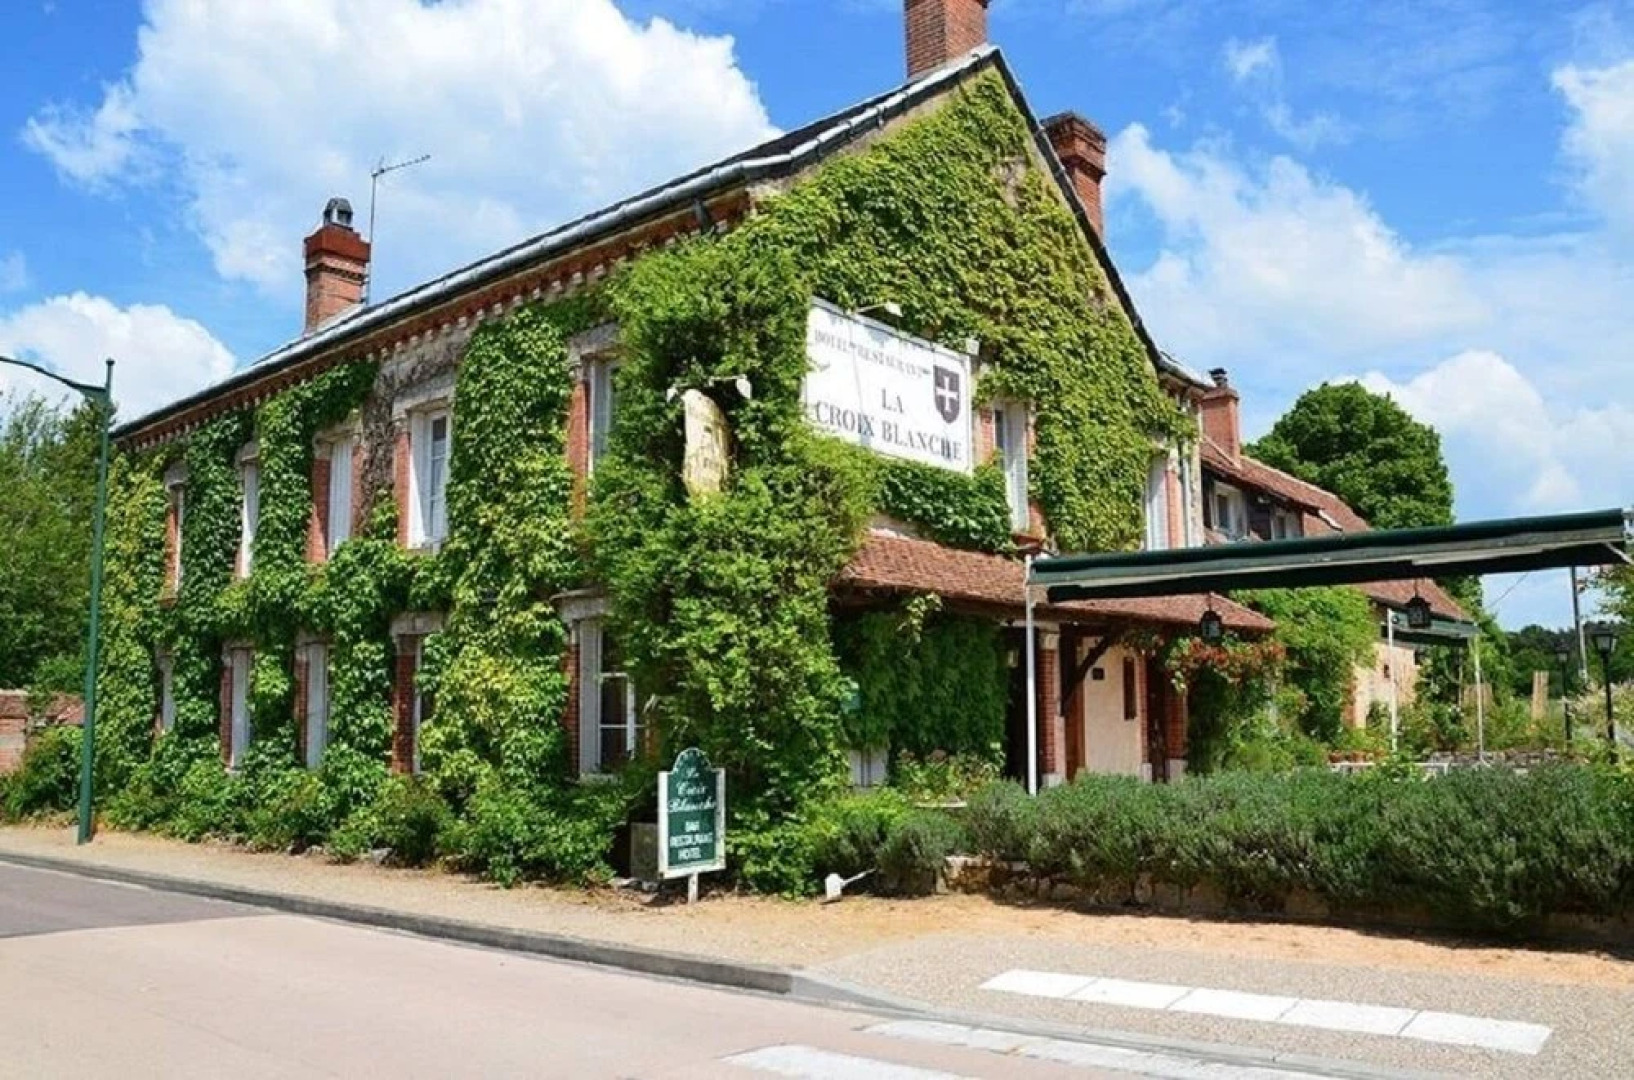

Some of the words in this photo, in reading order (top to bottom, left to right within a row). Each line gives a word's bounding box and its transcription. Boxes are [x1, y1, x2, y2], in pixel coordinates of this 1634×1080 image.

[881, 388, 904, 414] LA
[816, 401, 874, 437] CROIX
[881, 420, 962, 461] BLANCHE
